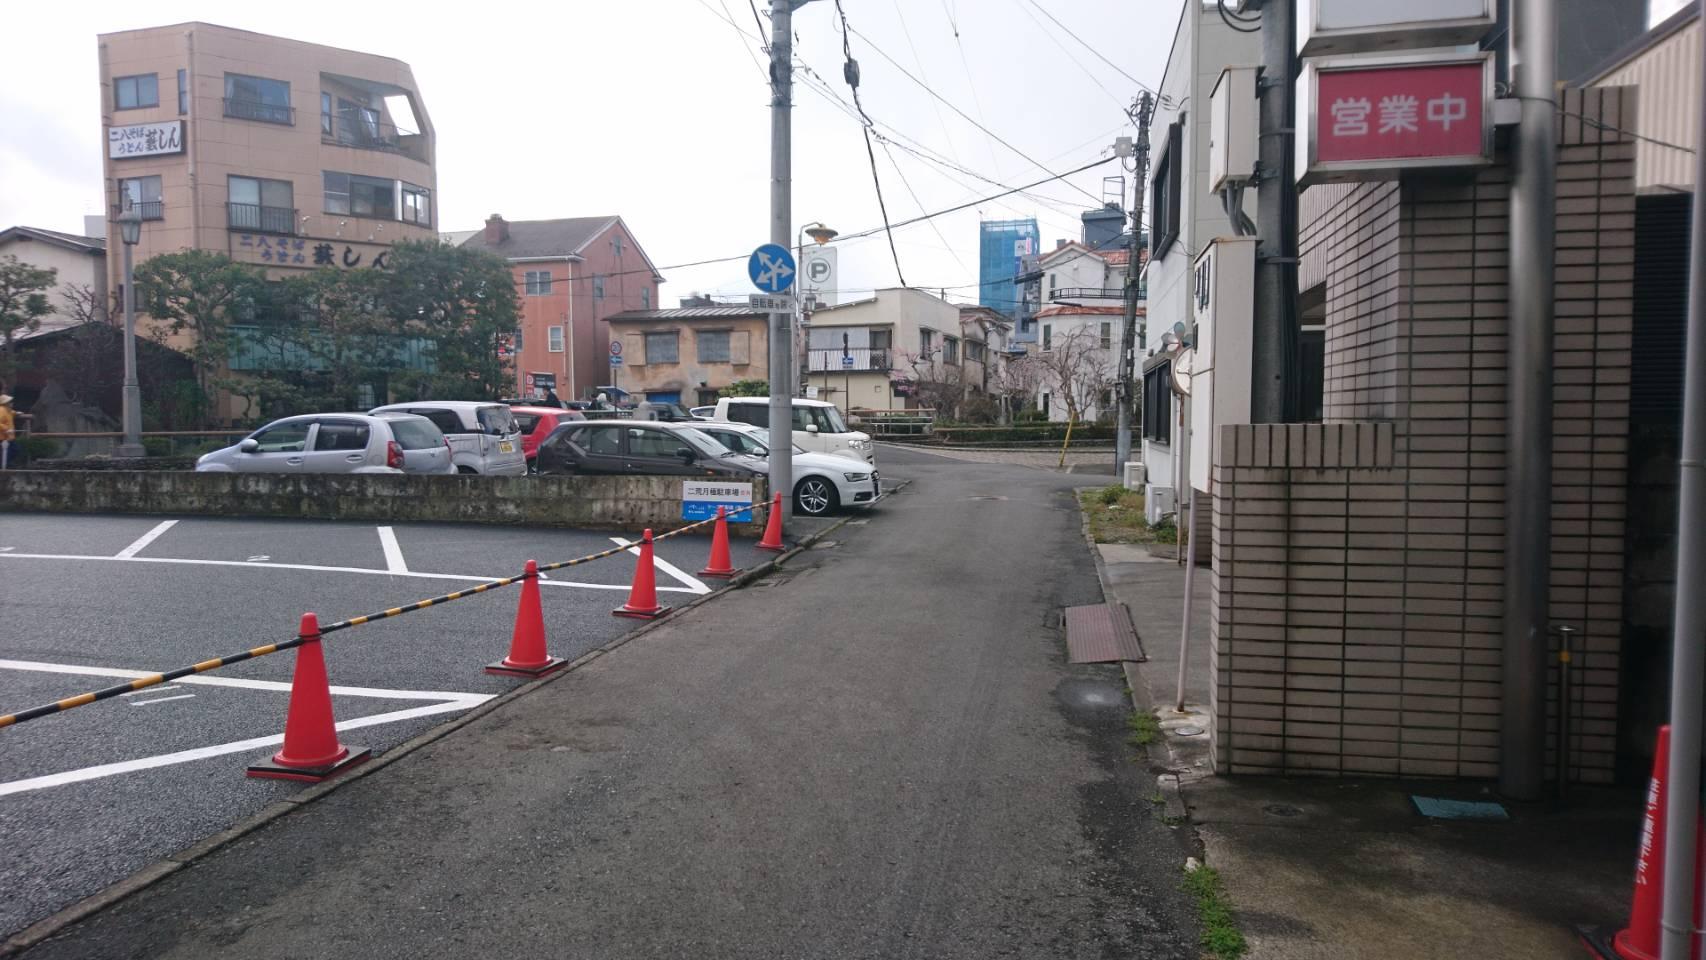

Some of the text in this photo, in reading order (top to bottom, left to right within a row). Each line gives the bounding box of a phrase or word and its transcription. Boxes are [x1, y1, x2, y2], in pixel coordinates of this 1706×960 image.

[1330, 92, 1467, 137] 営業中
[110, 128, 145, 142] 二八そば
[118, 142, 144, 154] うどん
[241, 236, 305, 249] 二八そば
[261, 249, 305, 264] うどん
[811, 262, 828, 278] P
